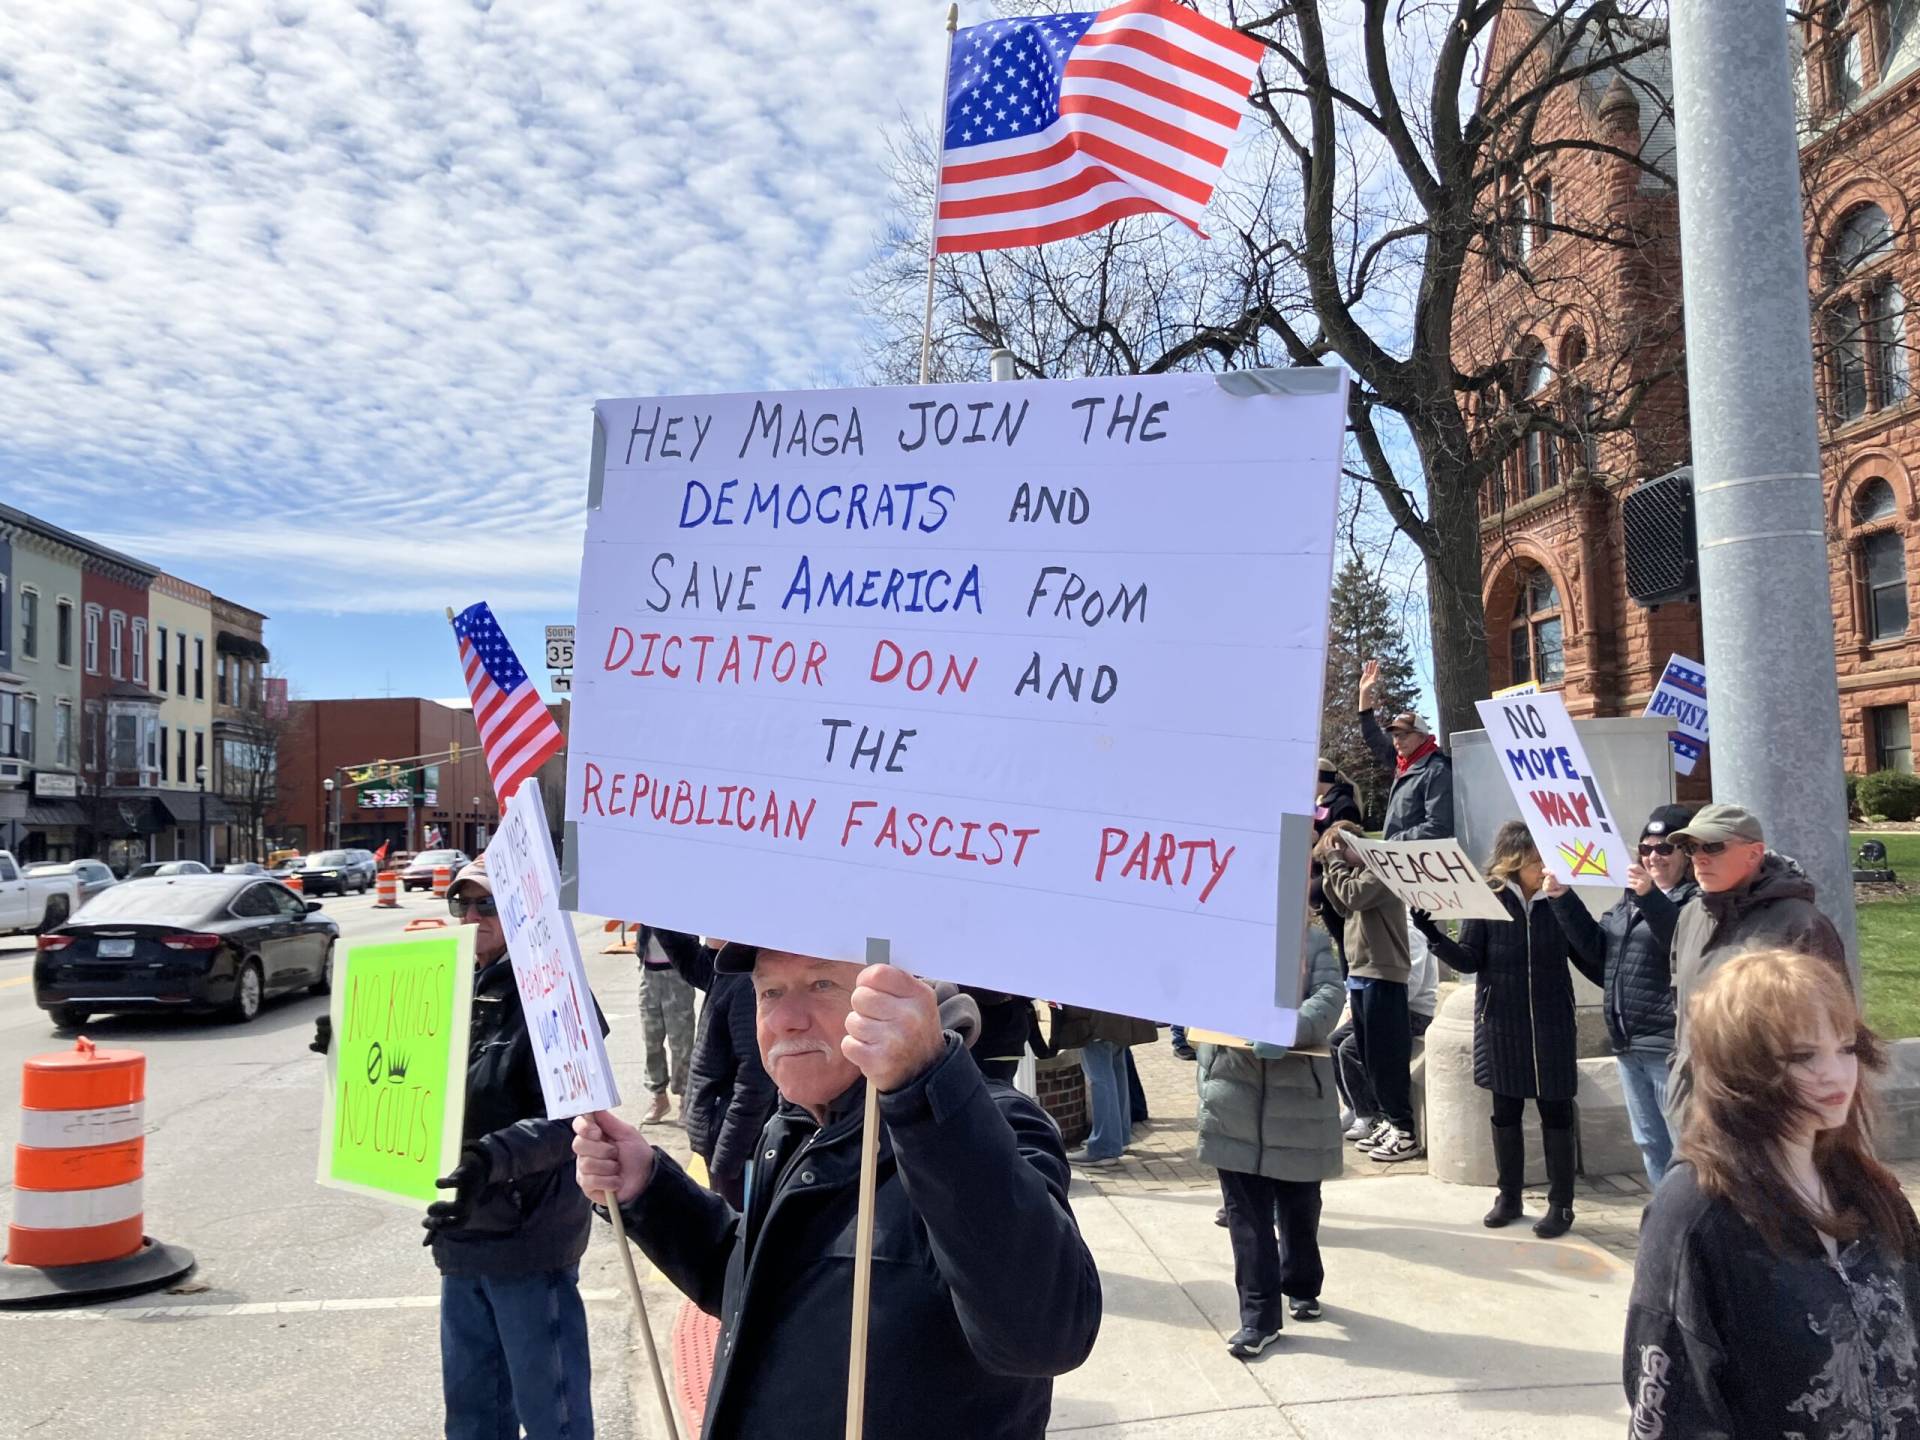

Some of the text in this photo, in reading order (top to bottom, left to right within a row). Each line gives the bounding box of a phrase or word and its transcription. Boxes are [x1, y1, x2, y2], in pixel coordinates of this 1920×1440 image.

[626, 392, 1169, 464] HEY MAGA JOIN THE
[679, 479, 1089, 533] DEMOCRATS AND
[647, 553, 1147, 627] SAVE AMERICA FROM
[547, 628, 573, 637] SOUTH
[549, 646, 573, 662] 35
[604, 626, 1118, 704] DICTATOR DON AND
[822, 719, 917, 772] THE
[1503, 704, 1546, 739] NO
[583, 763, 1235, 903] REPUBLICAN FASCIST PARTY
[1398, 888, 1465, 912] NOW
[349, 963, 445, 1042] NO KINGS
[340, 1081, 432, 1163] NO CULTS
